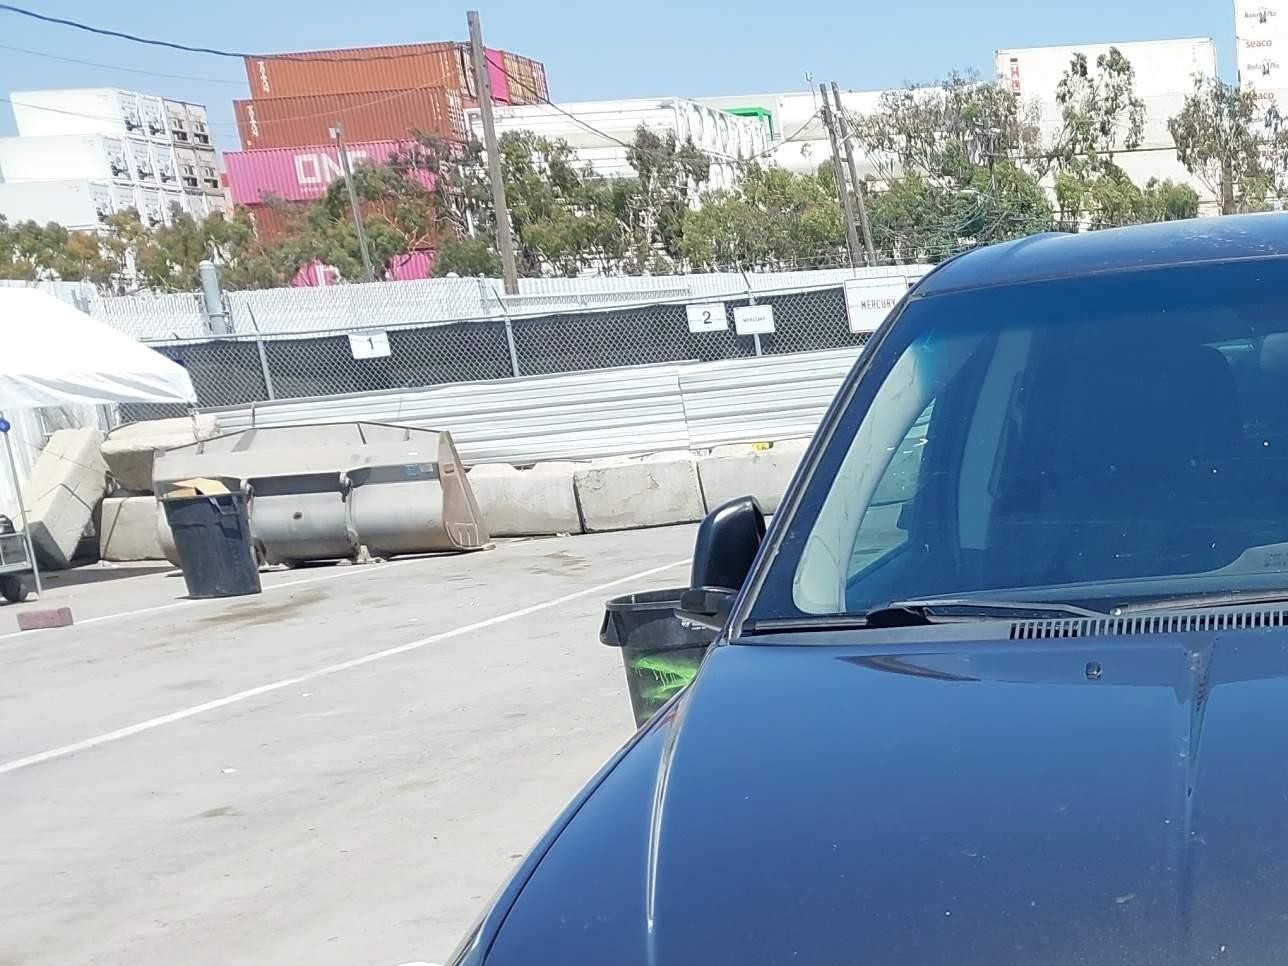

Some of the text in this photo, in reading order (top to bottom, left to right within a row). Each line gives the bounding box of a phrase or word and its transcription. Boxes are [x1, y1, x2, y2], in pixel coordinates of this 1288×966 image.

[1245, 39, 1272, 48] seaco
[861, 297, 896, 310] MERCURY
[702, 311, 712, 325] 2
[367, 336, 374, 350] 1
